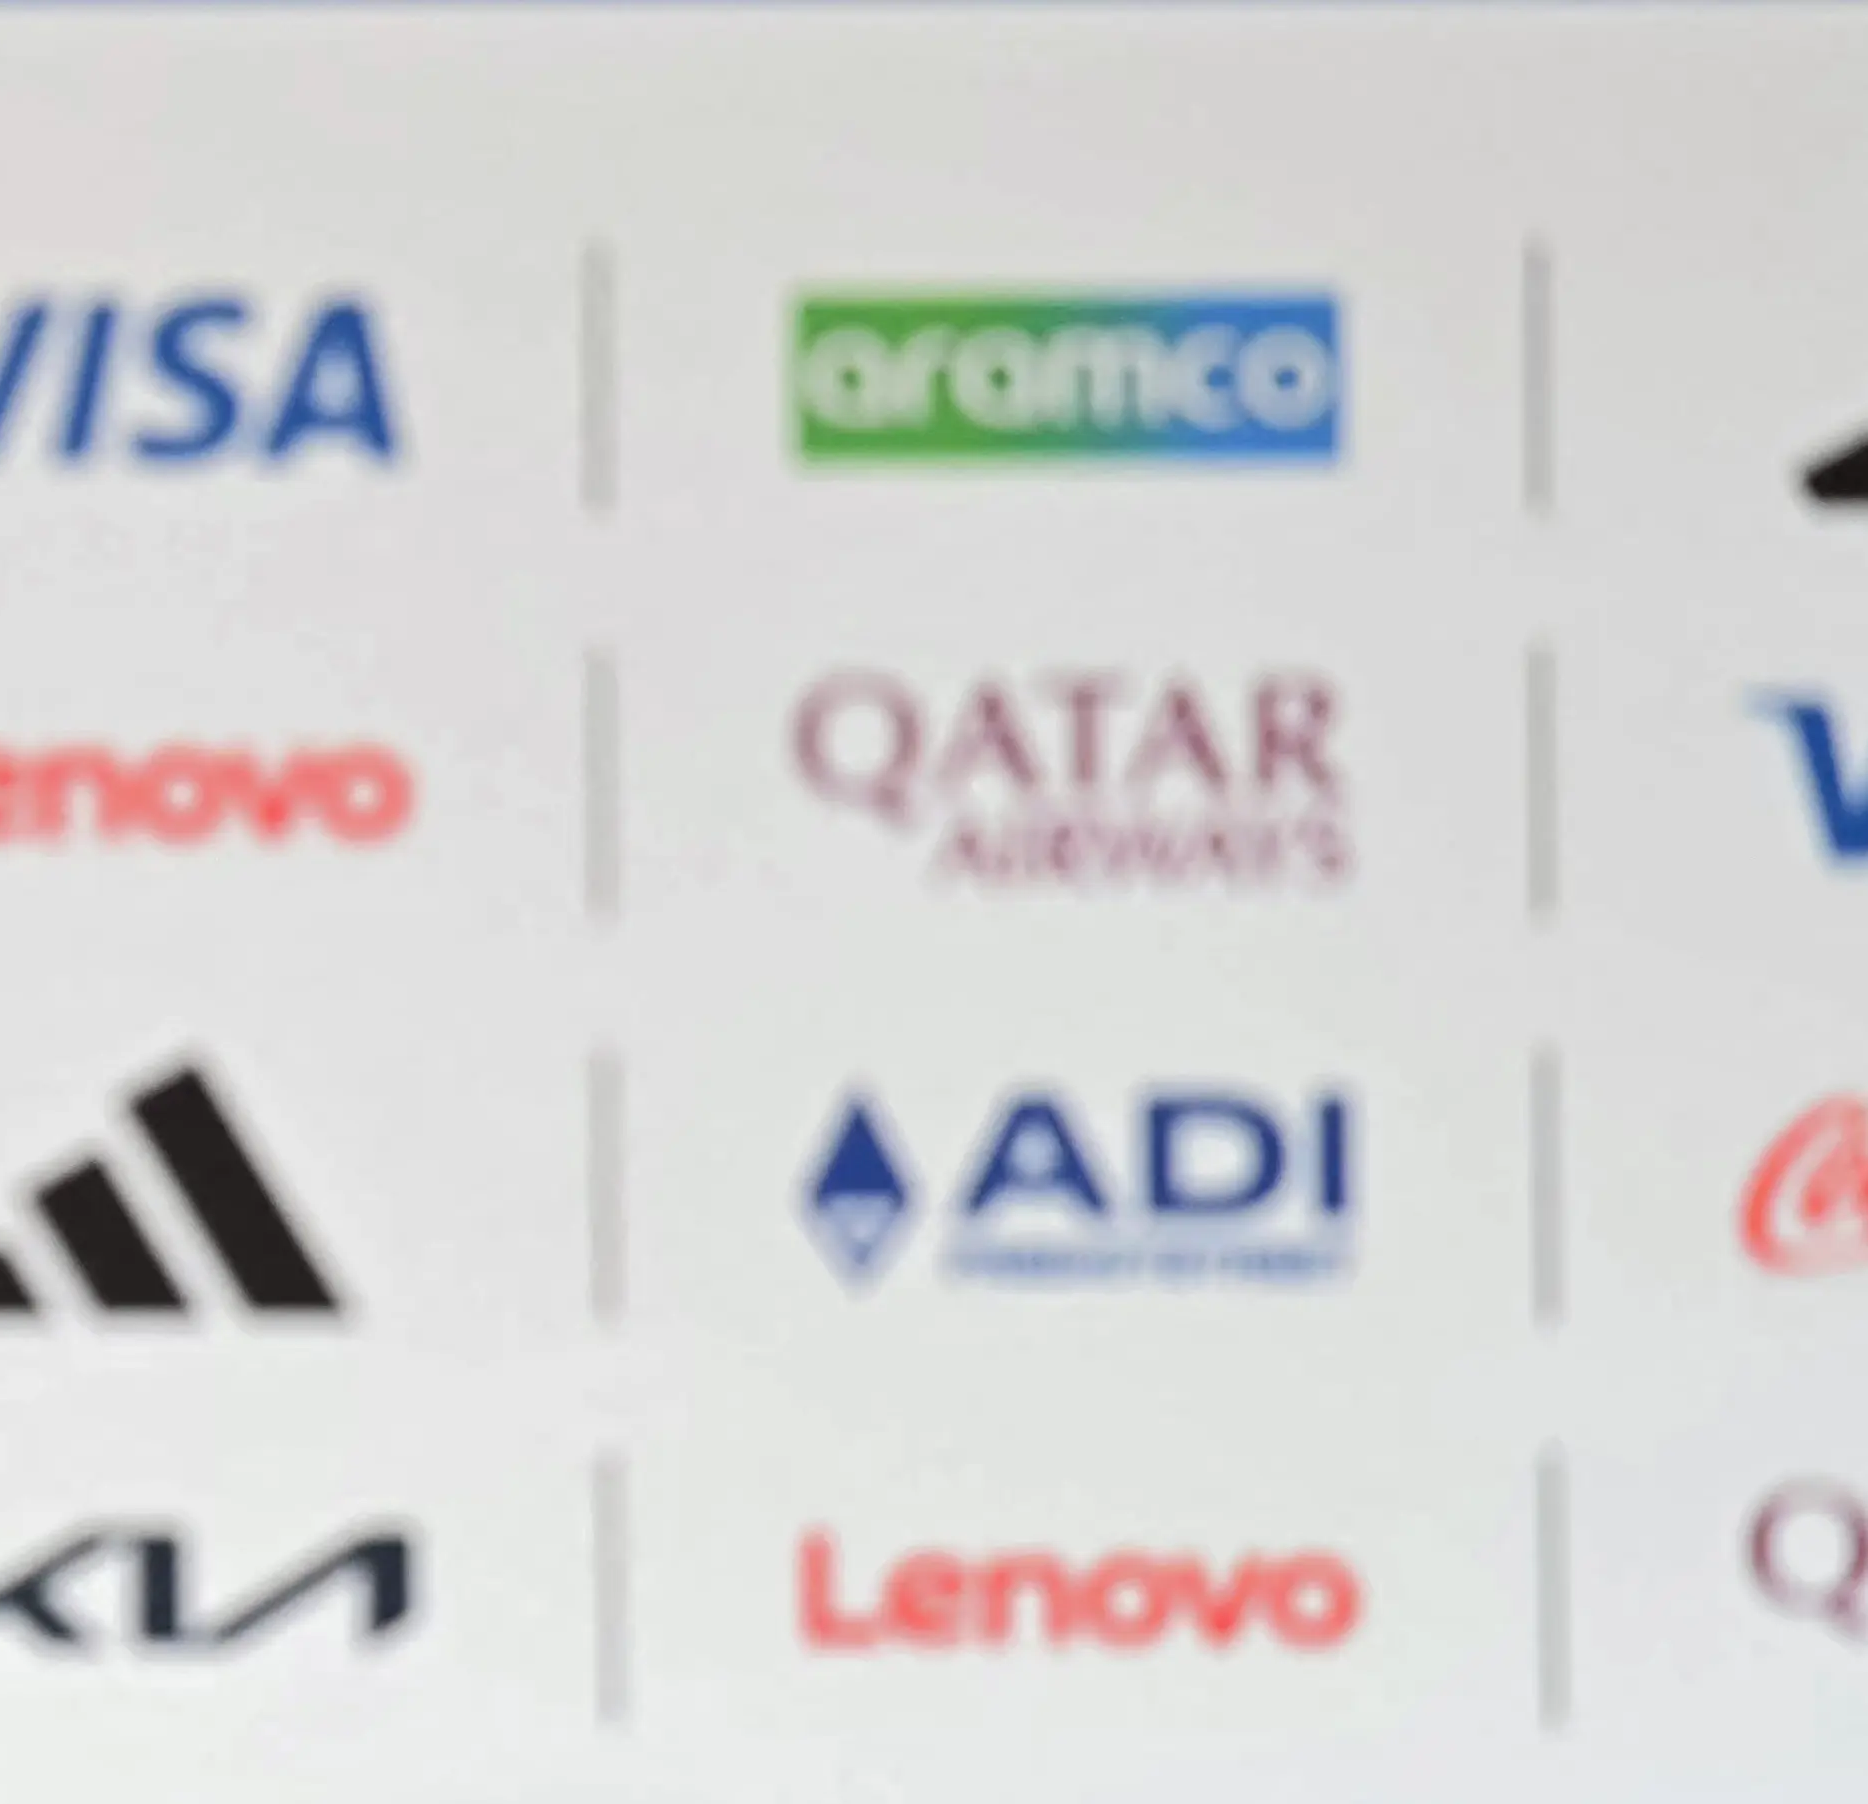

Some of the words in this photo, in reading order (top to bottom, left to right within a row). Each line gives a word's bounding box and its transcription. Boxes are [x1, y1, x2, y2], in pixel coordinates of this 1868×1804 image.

[804, 322, 1335, 432] aramco
[790, 673, 1341, 832] QATAR
[959, 1092, 1352, 1221] ADI
[796, 1530, 1365, 1653] Lenovo
